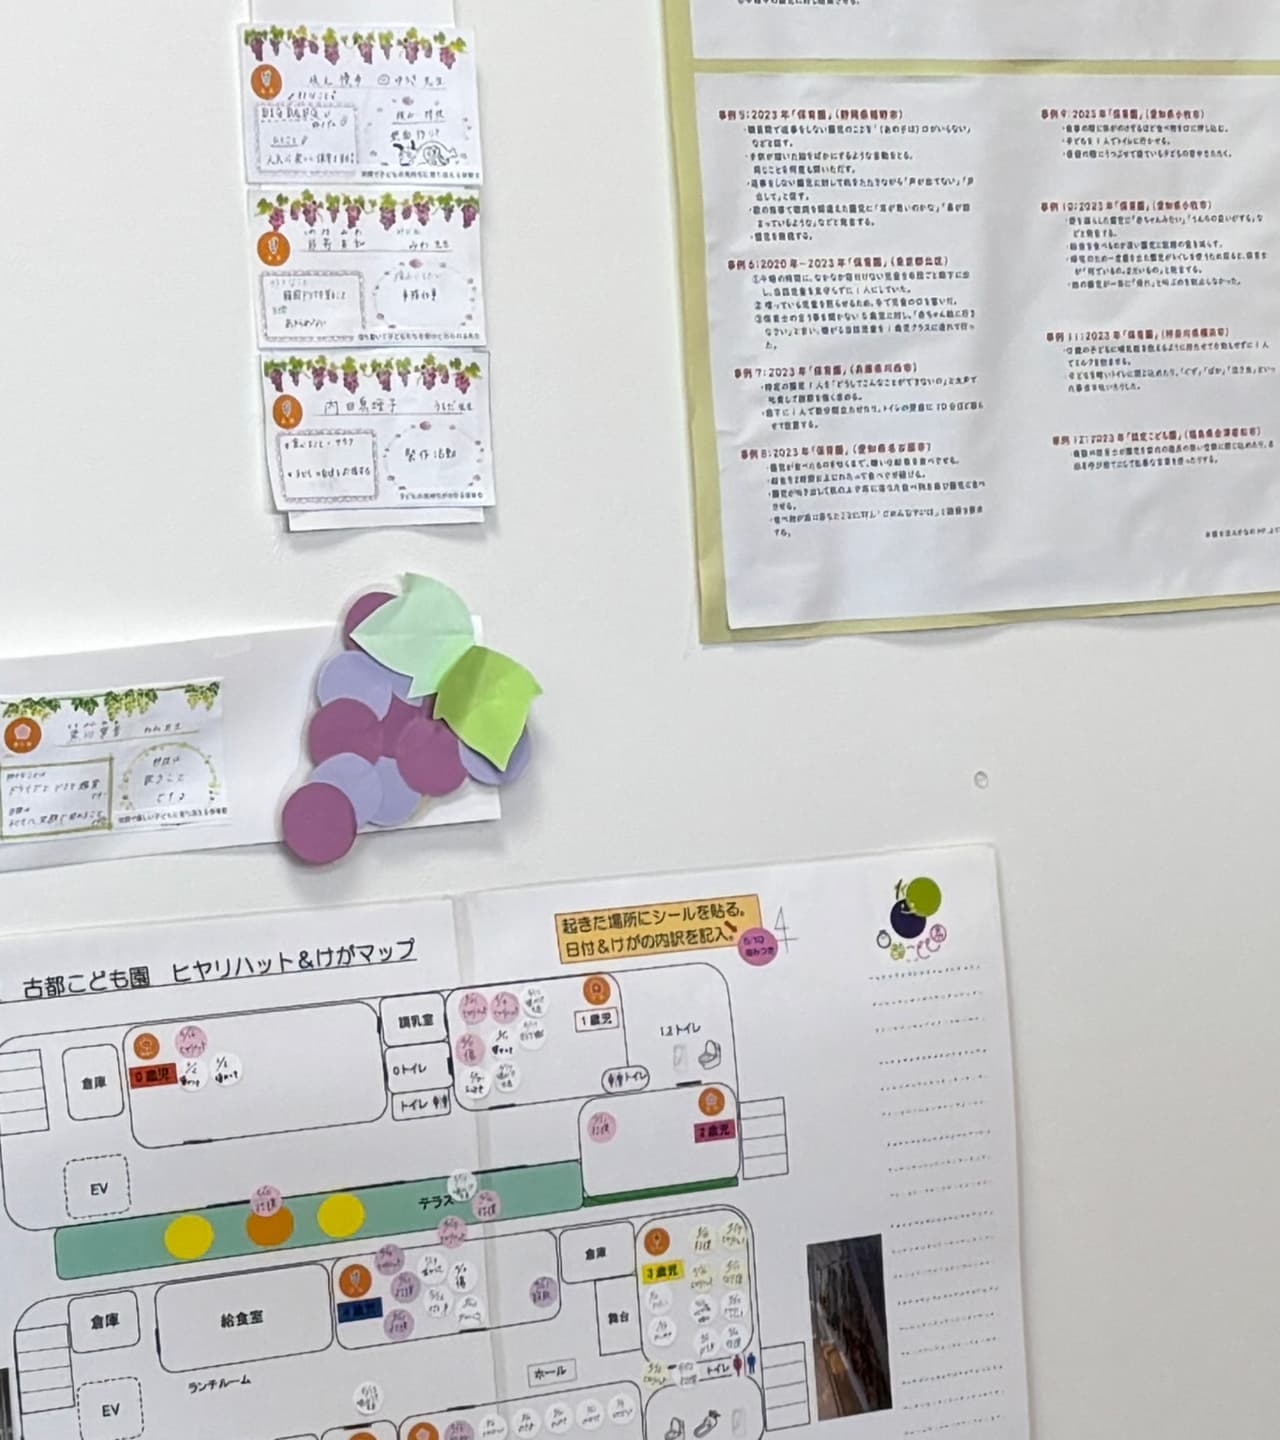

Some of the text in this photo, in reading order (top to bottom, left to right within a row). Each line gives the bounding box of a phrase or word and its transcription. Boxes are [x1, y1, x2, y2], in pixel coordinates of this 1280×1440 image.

[562, 907, 745, 933] 起きた場所にシールを貼る。
[23, 966, 150, 999] 古都こども園
[81, 1075, 108, 1091] 倉庫
[90, 1183, 108, 1196] EV
[418, 1194, 454, 1210] テラス
[90, 1313, 119, 1329] 倉庫
[220, 1310, 264, 1328] 給食室
[533, 1365, 567, 1380] ホール
[188, 1375, 252, 1394] ランチルーム
[102, 1403, 119, 1416] EV
